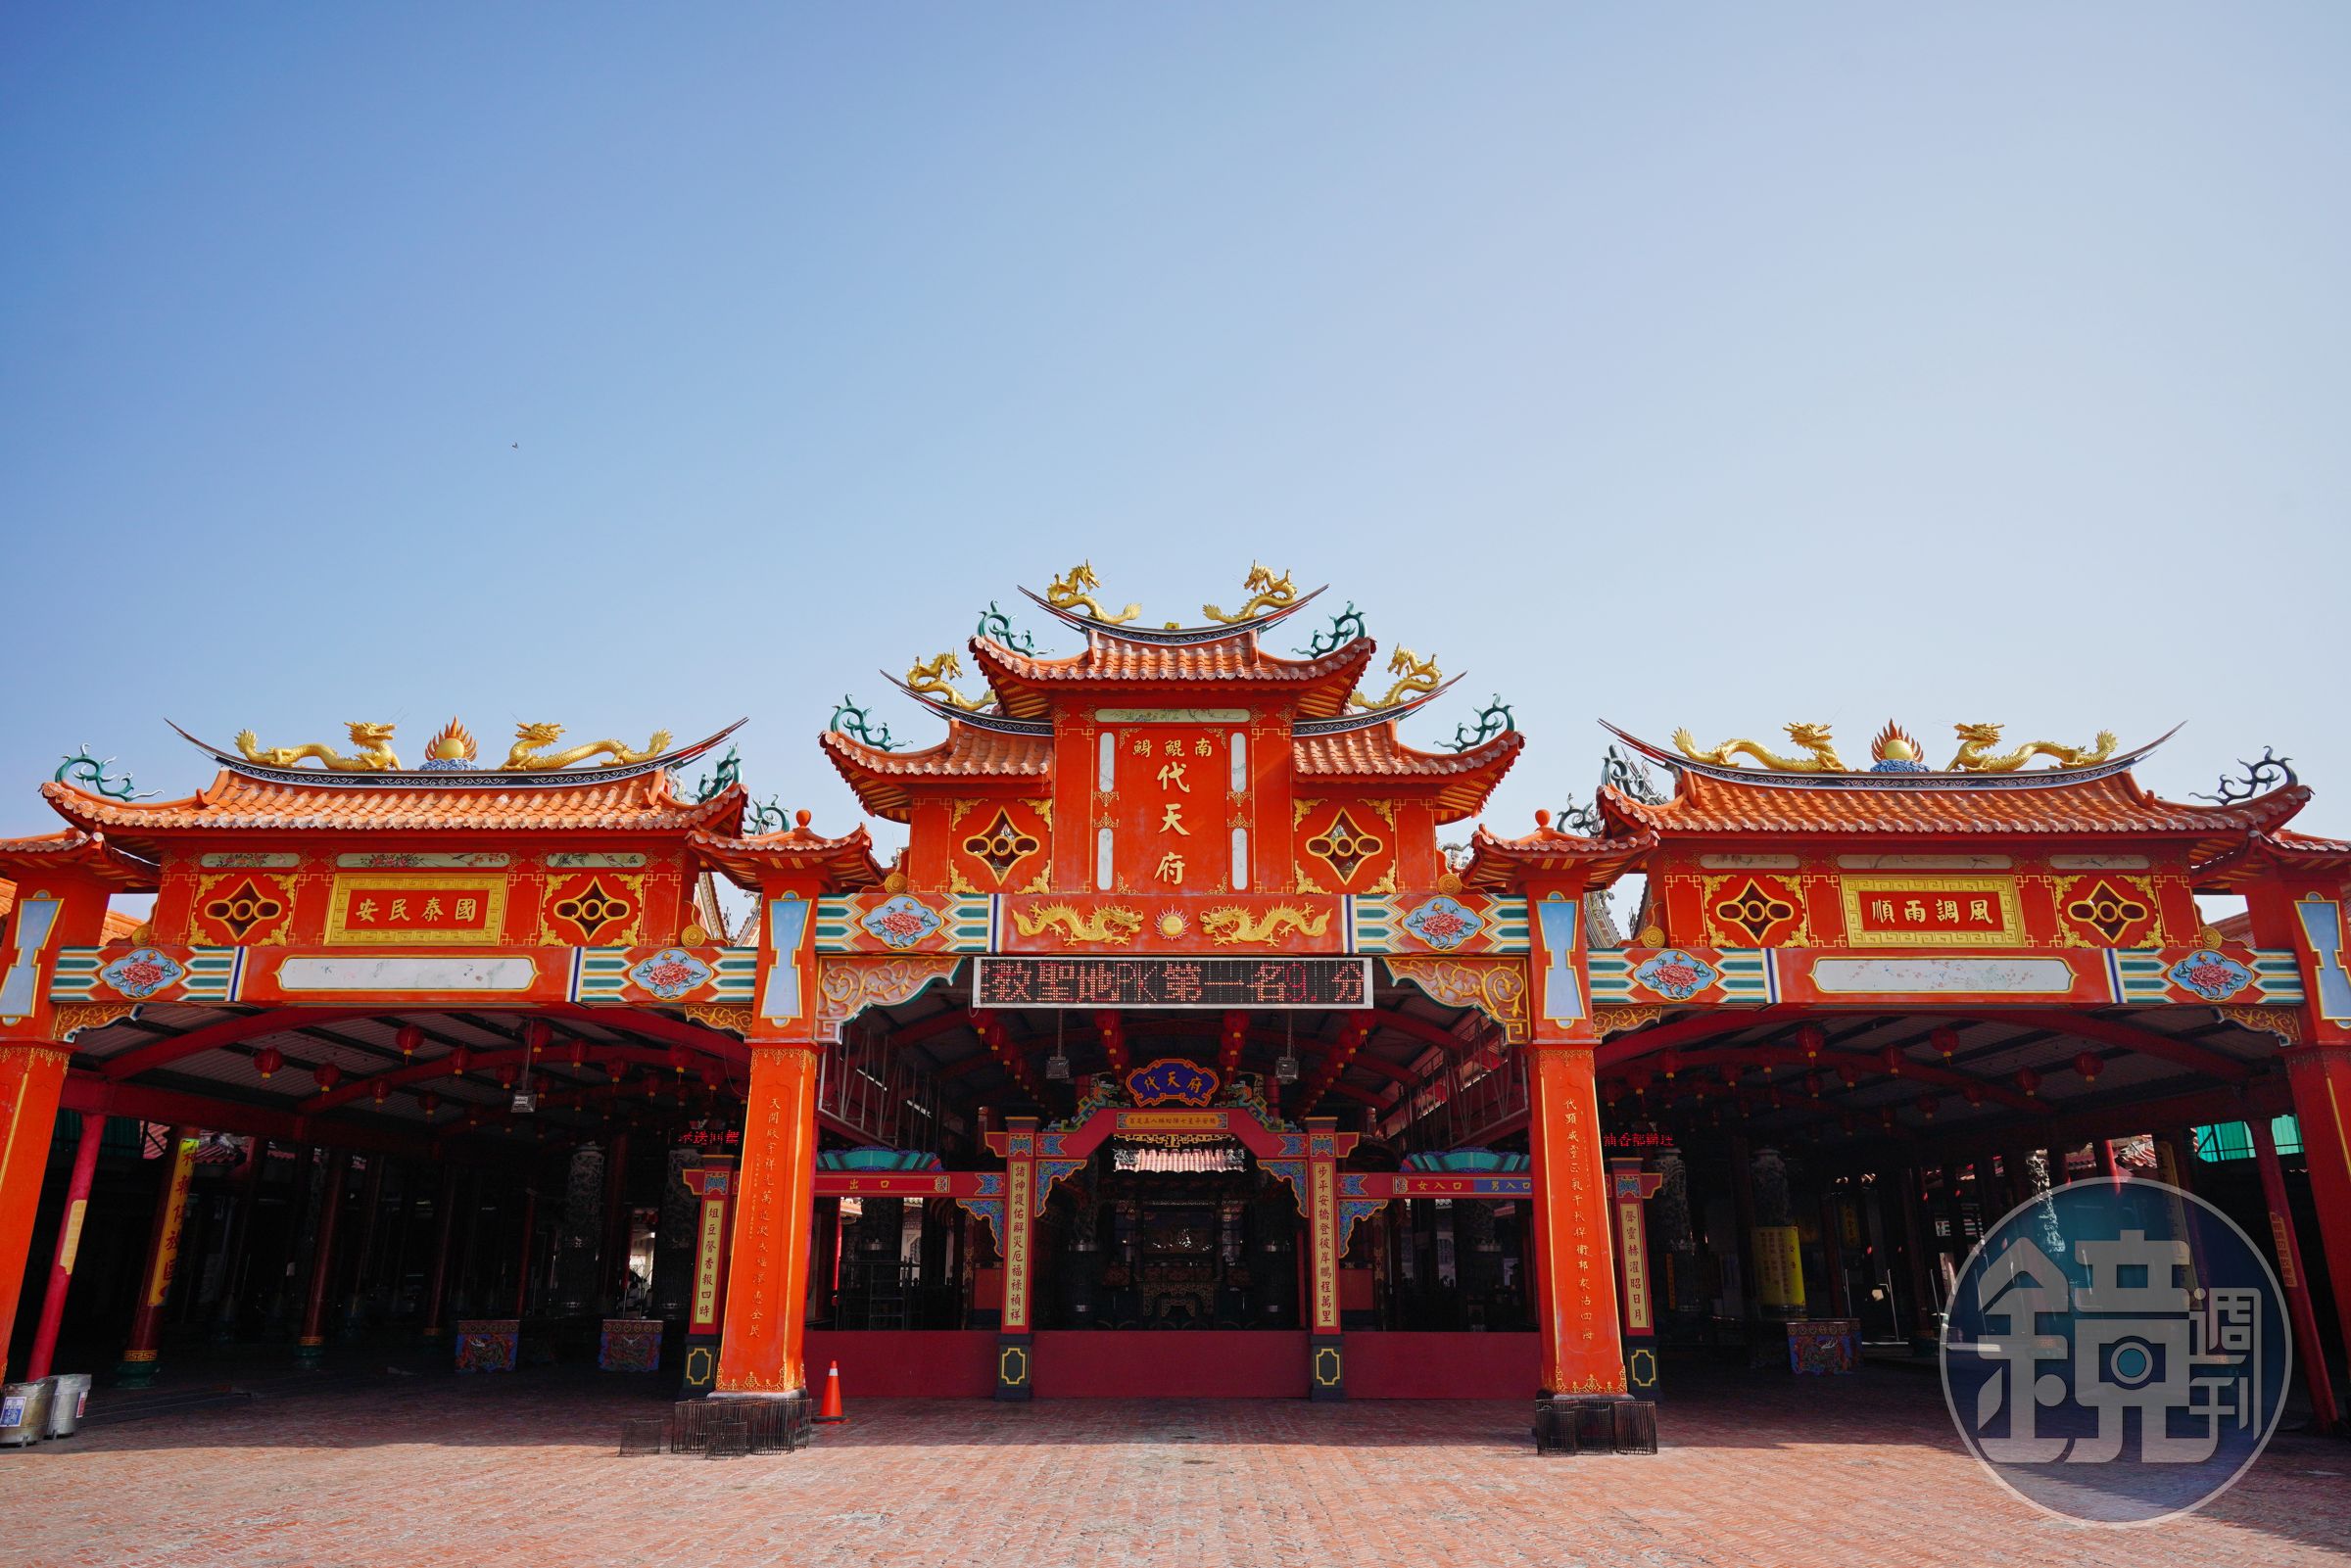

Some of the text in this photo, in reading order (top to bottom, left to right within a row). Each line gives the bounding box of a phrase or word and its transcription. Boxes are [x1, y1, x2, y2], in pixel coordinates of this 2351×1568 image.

[1132, 737, 1213, 758] 南鯤鯓
[1153, 761, 1191, 885] 代天府
[355, 896, 478, 923] 國泰民安
[1871, 898, 1993, 925] 風調雨順
[1143, 1070, 1203, 1094] 代天府
[848, 1178, 890, 1191] 出口
[1416, 1180, 1463, 1191] 女入口
[1491, 1180, 1531, 1192] 男入口
